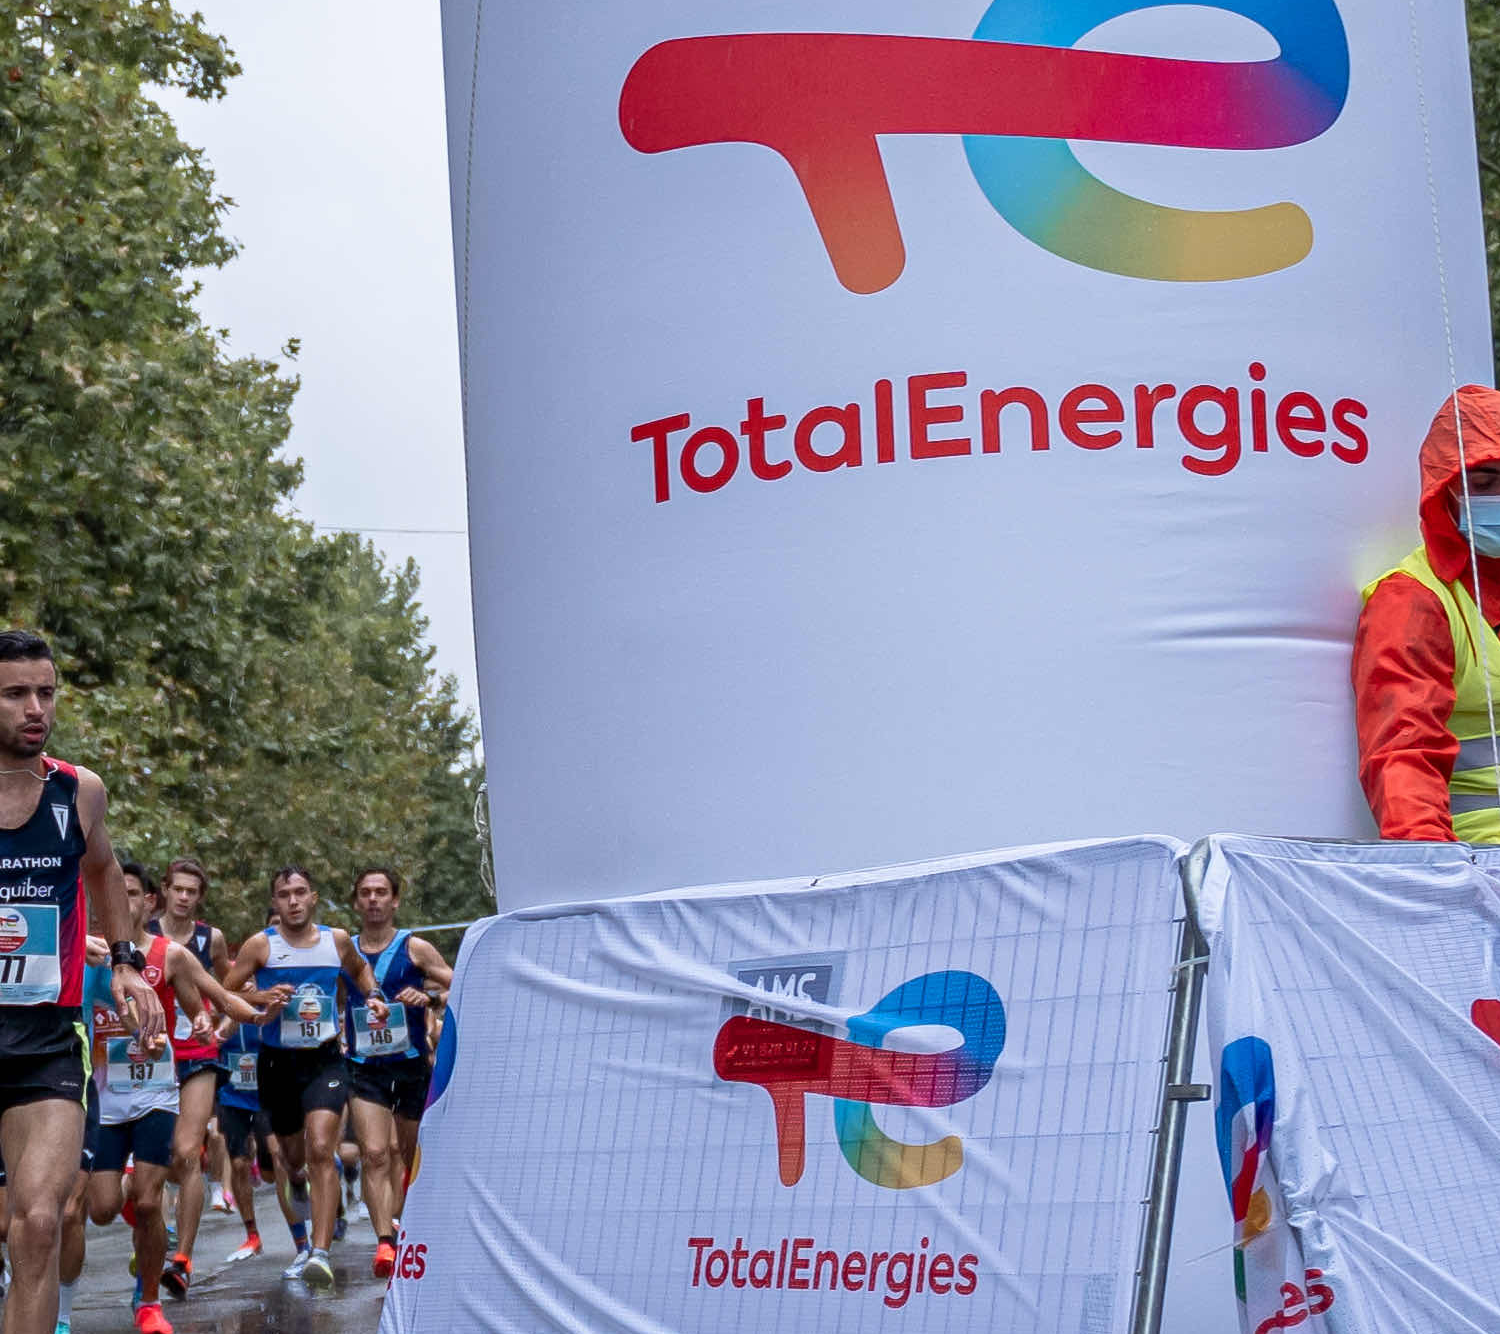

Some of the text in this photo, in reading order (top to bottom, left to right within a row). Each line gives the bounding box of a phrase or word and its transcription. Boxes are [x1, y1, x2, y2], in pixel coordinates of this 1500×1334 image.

[630, 362, 1369, 503] TotalEnergies
[299, 1022, 321, 1038] 151
[369, 1028, 393, 1046] 146
[128, 1063, 154, 1081] 137
[687, 1236, 979, 1309] TotalEnergies
